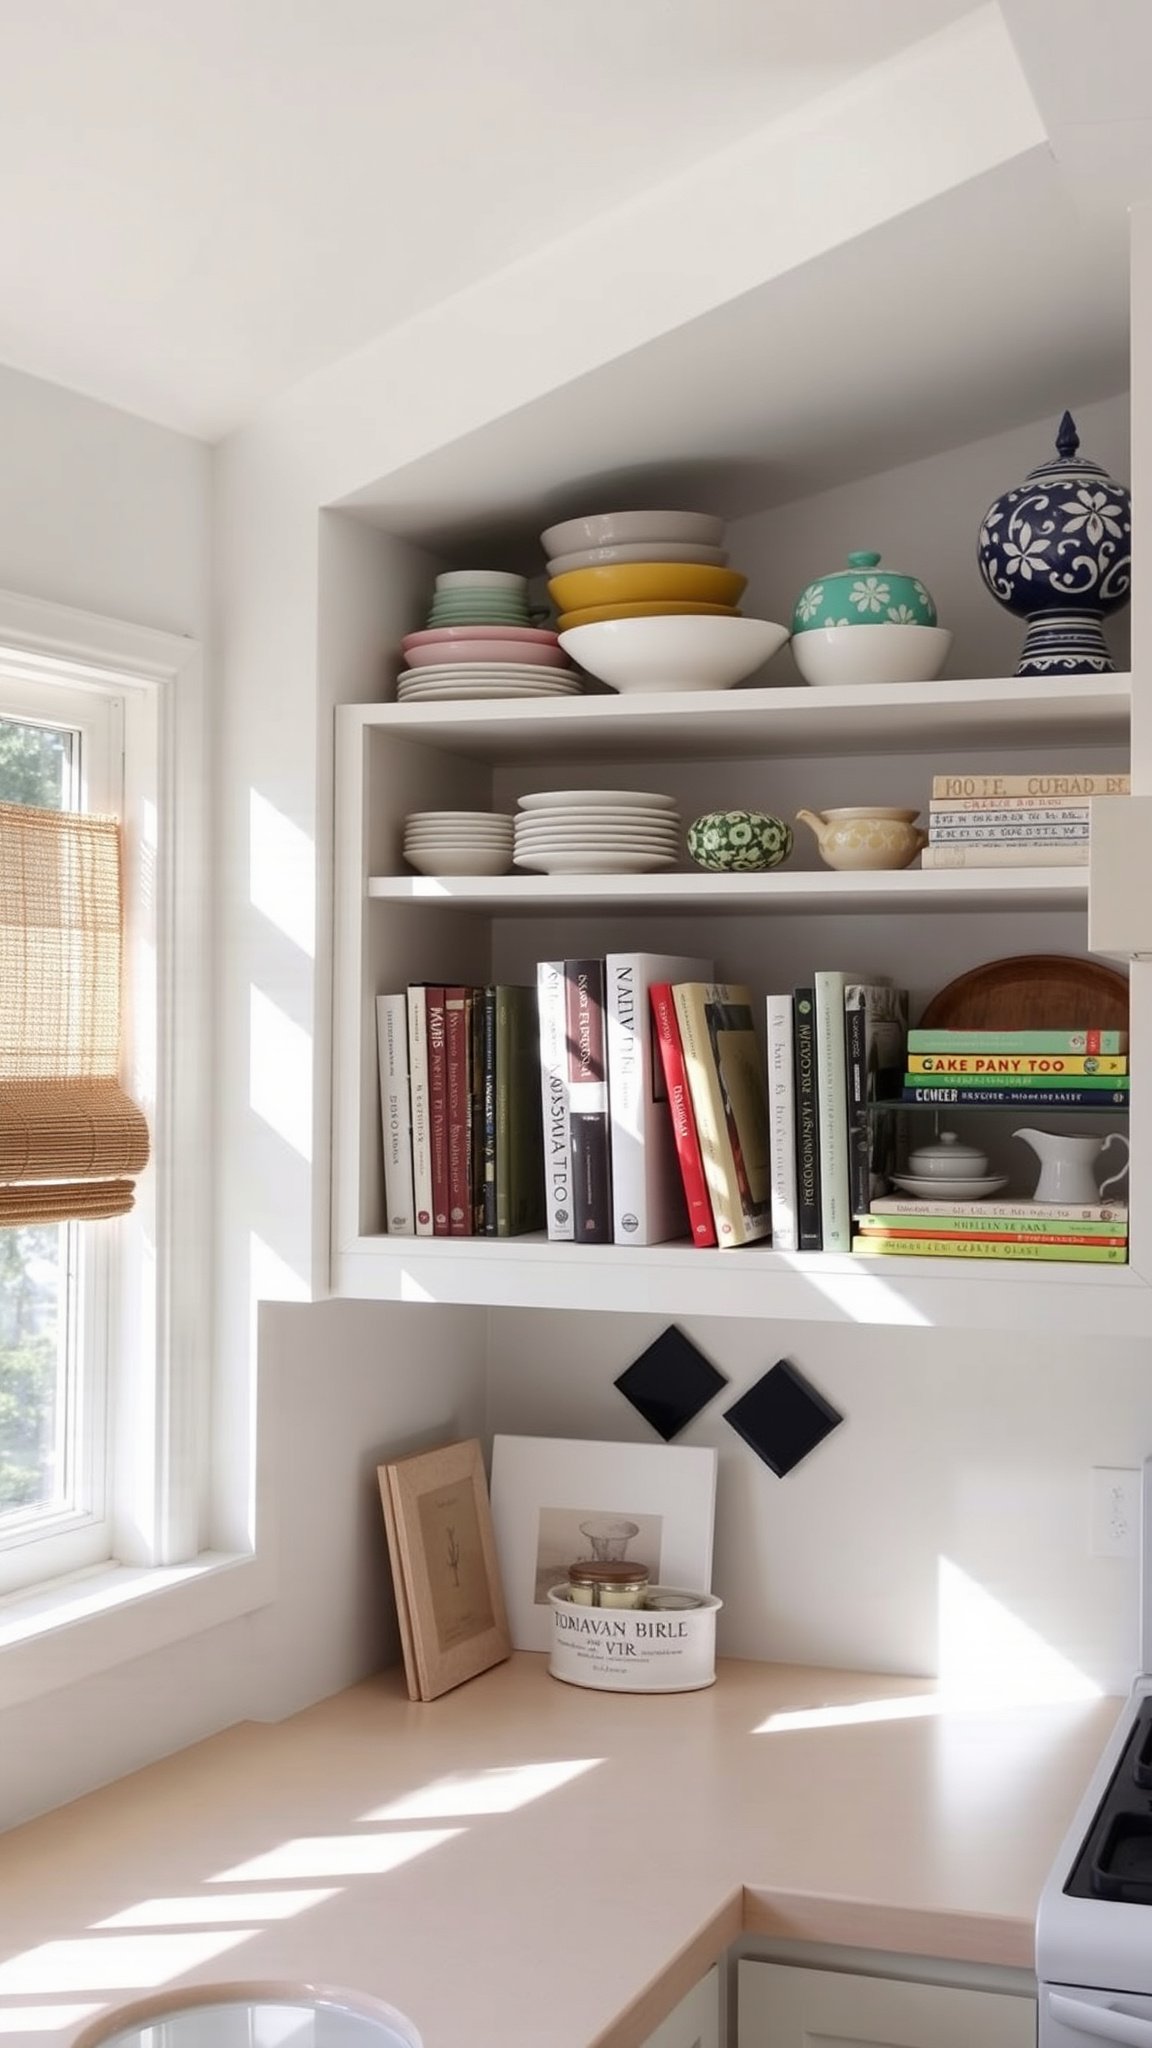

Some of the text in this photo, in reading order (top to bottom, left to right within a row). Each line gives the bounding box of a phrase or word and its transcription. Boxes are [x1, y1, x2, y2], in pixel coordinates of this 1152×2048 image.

[922, 1057, 1065, 1071] CAKE PANY TOO
